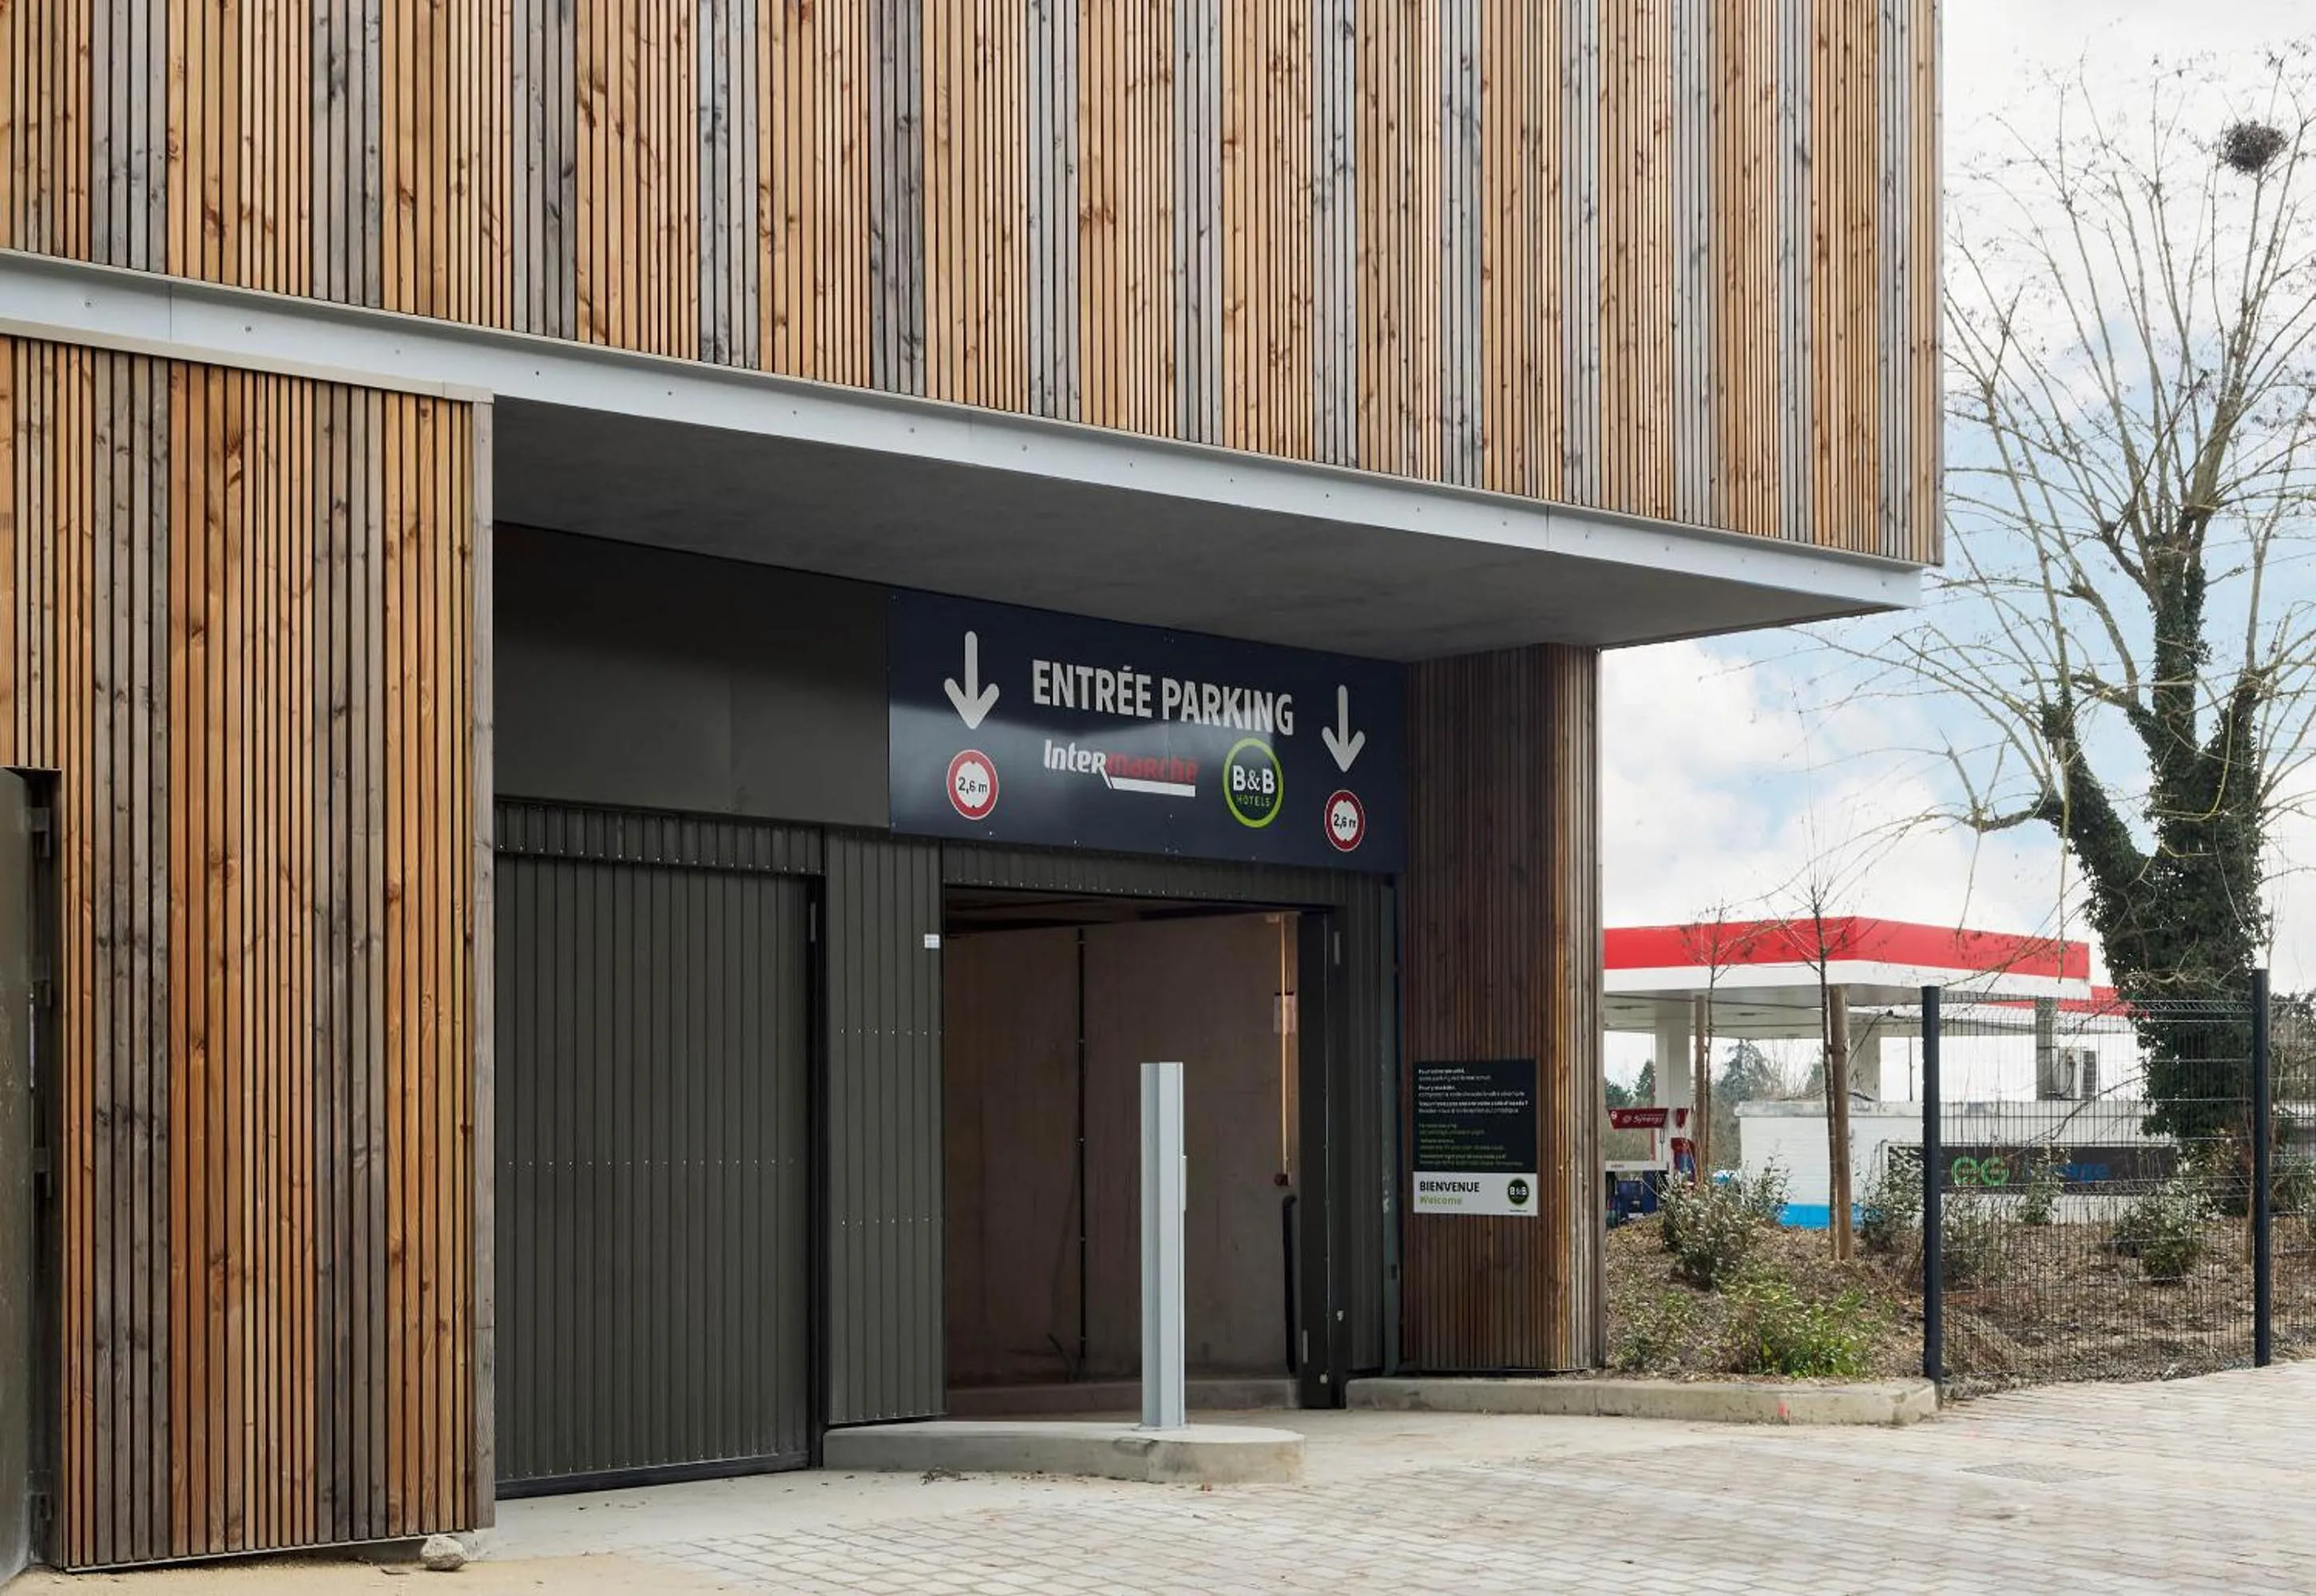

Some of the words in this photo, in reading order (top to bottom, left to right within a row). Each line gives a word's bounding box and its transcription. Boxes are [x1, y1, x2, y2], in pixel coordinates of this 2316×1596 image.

[1033, 659, 1152, 718] ENTRÉE
[1162, 677, 1294, 735] PARKING
[958, 777, 976, 794] 2,6
[978, 783, 988, 793] m
[1233, 765, 1275, 794] B&B
[1237, 794, 1271, 807] HOTELS
[1334, 814, 1347, 829] 2,6
[1419, 1181, 1480, 1192] BIENVENUE
[1420, 1195, 1462, 1205] Welcome
